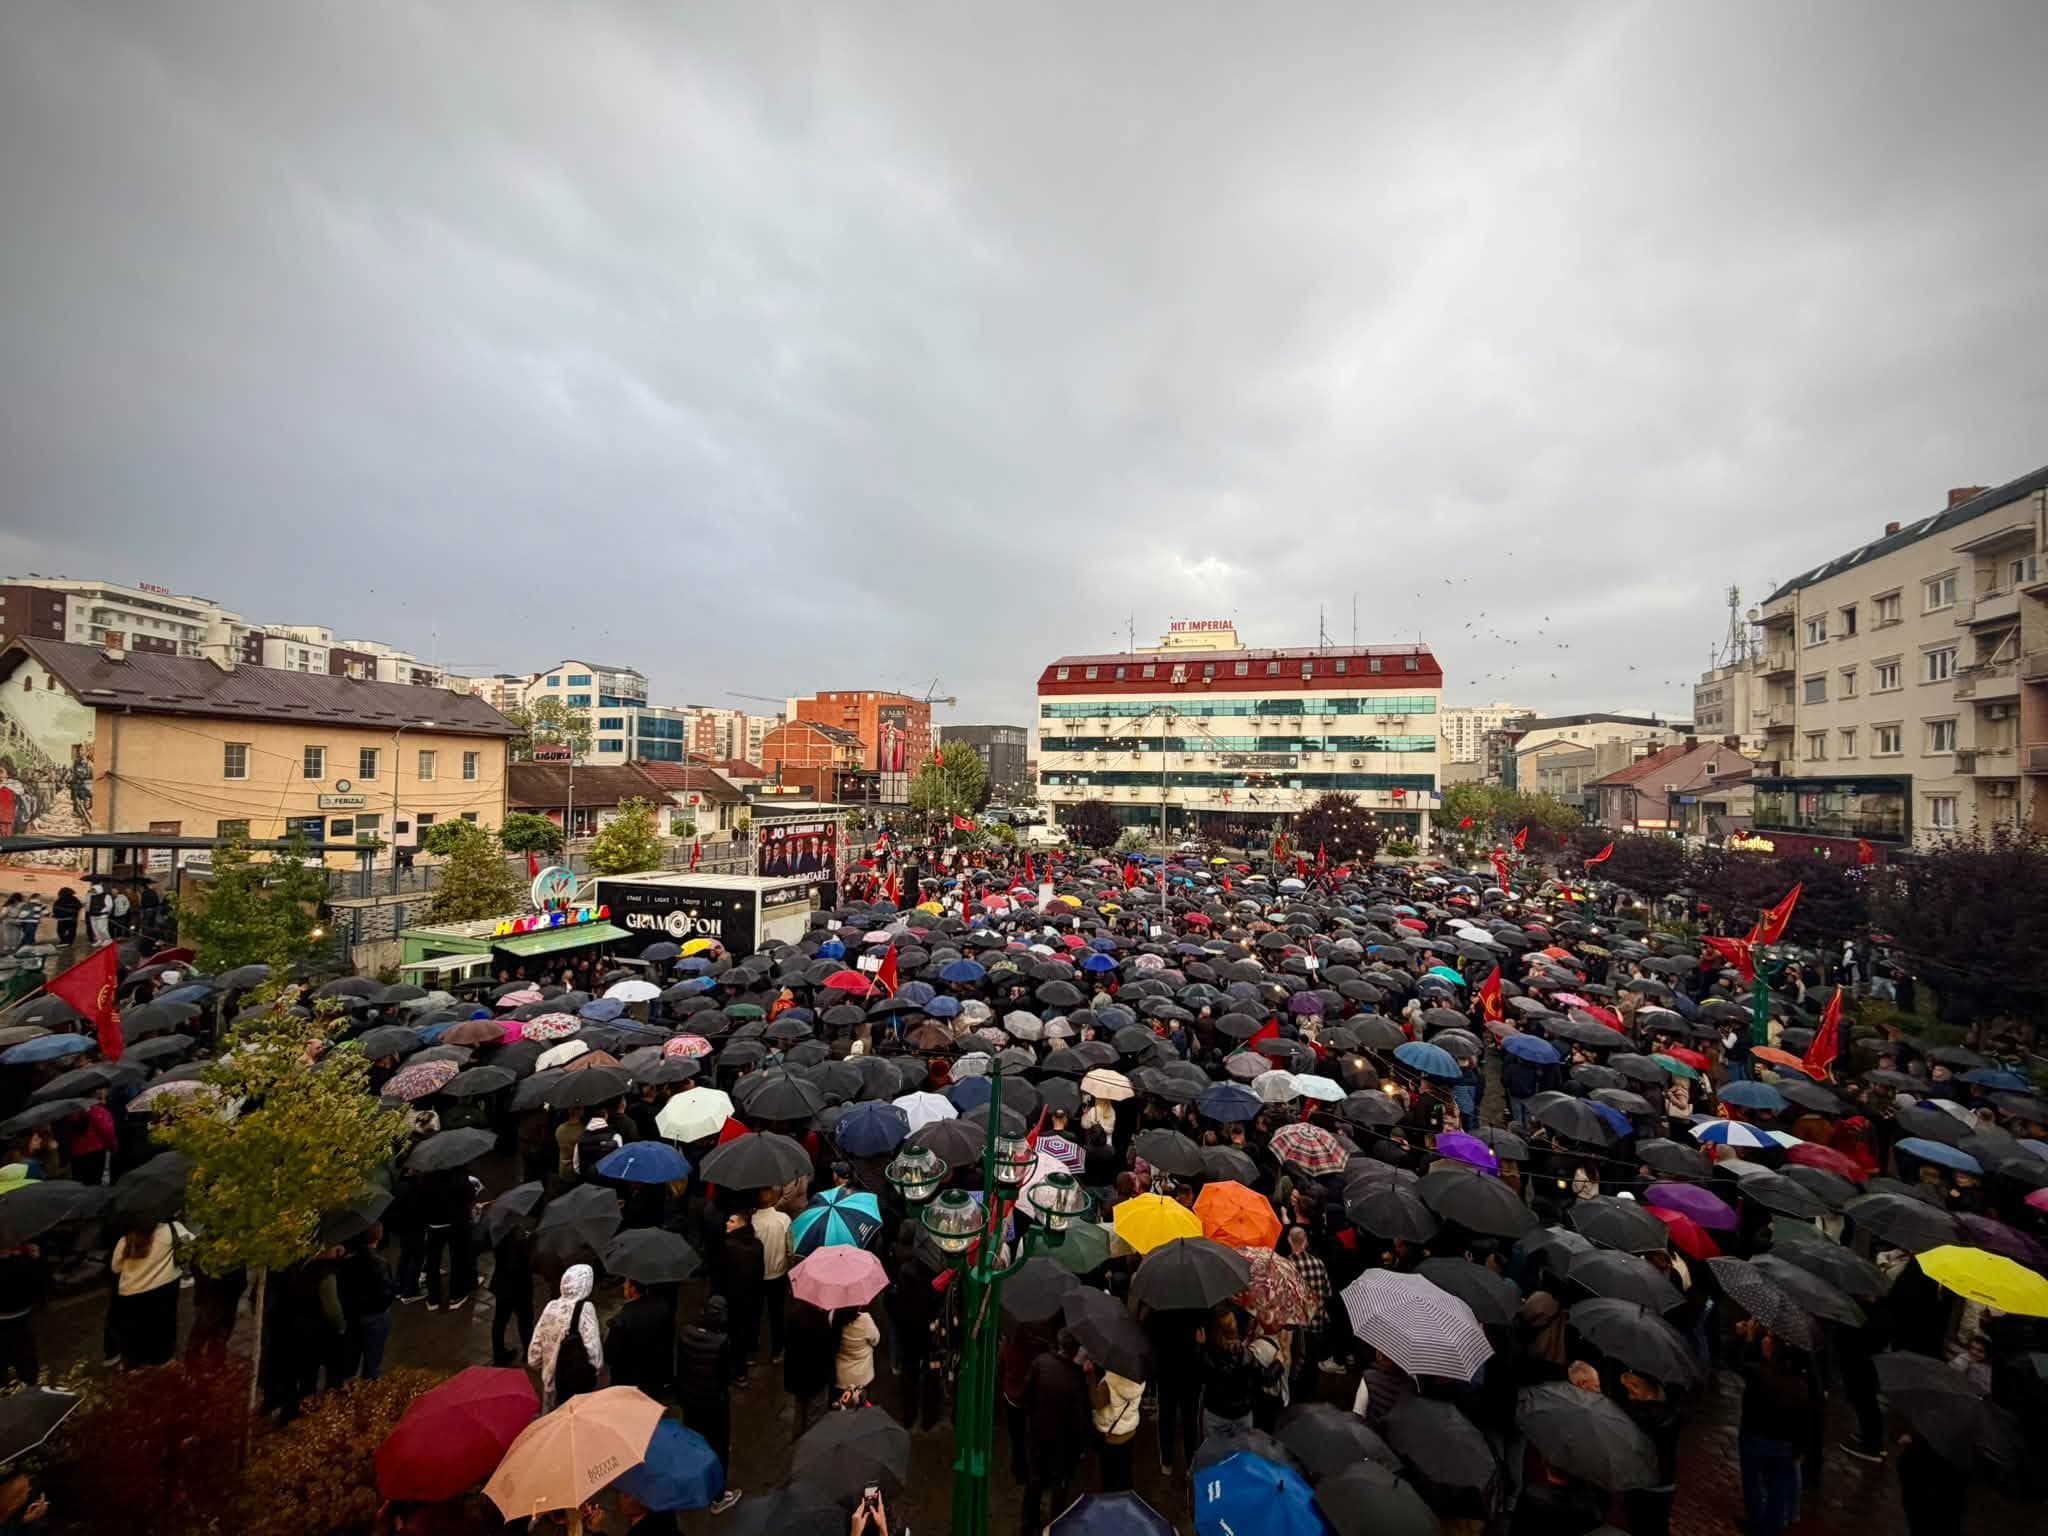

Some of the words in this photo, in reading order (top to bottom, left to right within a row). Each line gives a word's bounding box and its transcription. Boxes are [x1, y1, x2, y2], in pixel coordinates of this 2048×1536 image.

[1171, 622, 1185, 631] HIT
[1189, 620, 1232, 630] IMPERIAL
[770, 827, 784, 839] JO
